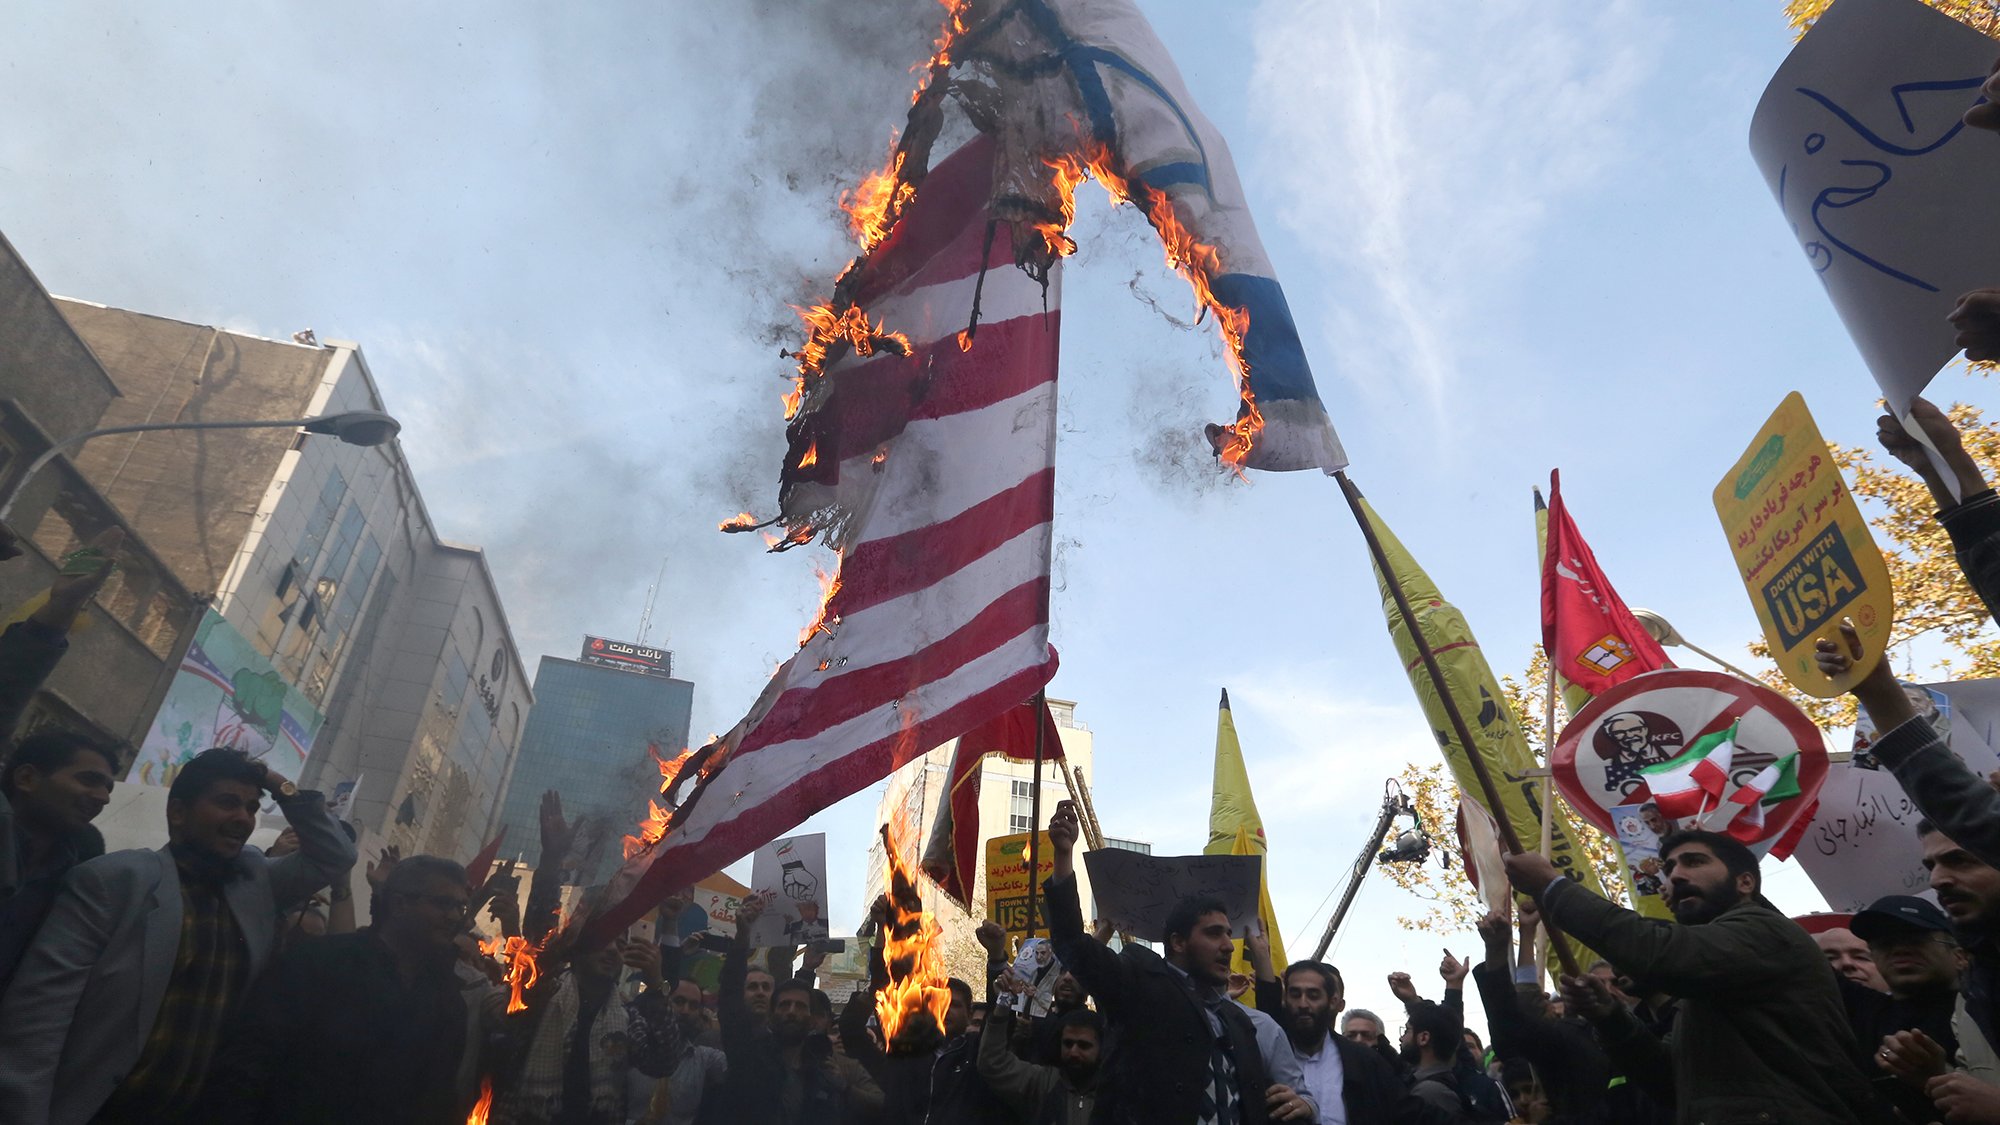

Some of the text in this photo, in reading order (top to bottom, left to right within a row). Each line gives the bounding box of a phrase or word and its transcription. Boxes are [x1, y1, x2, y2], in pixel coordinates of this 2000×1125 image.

[1832, 480, 1844, 507] بر
[1814, 496, 1828, 523] سر
[1770, 532, 1836, 598] DOWN WITH
[1775, 555, 1856, 637] USA
[609, 644, 633, 654] ملت
[1651, 732, 1680, 742] KFC
